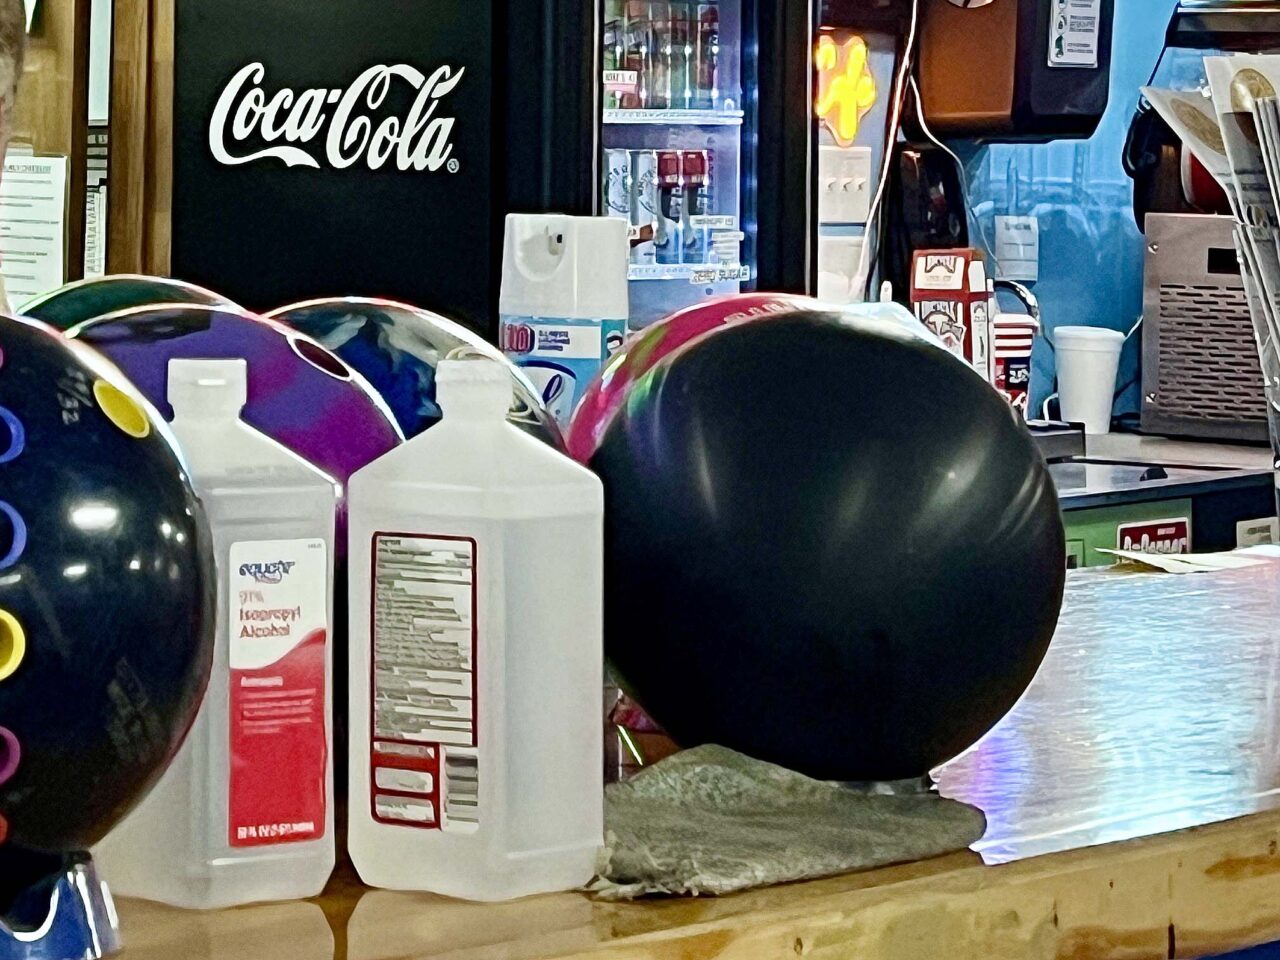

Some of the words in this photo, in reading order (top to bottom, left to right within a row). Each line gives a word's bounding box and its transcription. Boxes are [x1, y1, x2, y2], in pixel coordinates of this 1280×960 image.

[208, 61, 466, 173] Coca-Cola
[239, 605, 301, 622] Isopropyl
[239, 623, 291, 639] Alcohol
